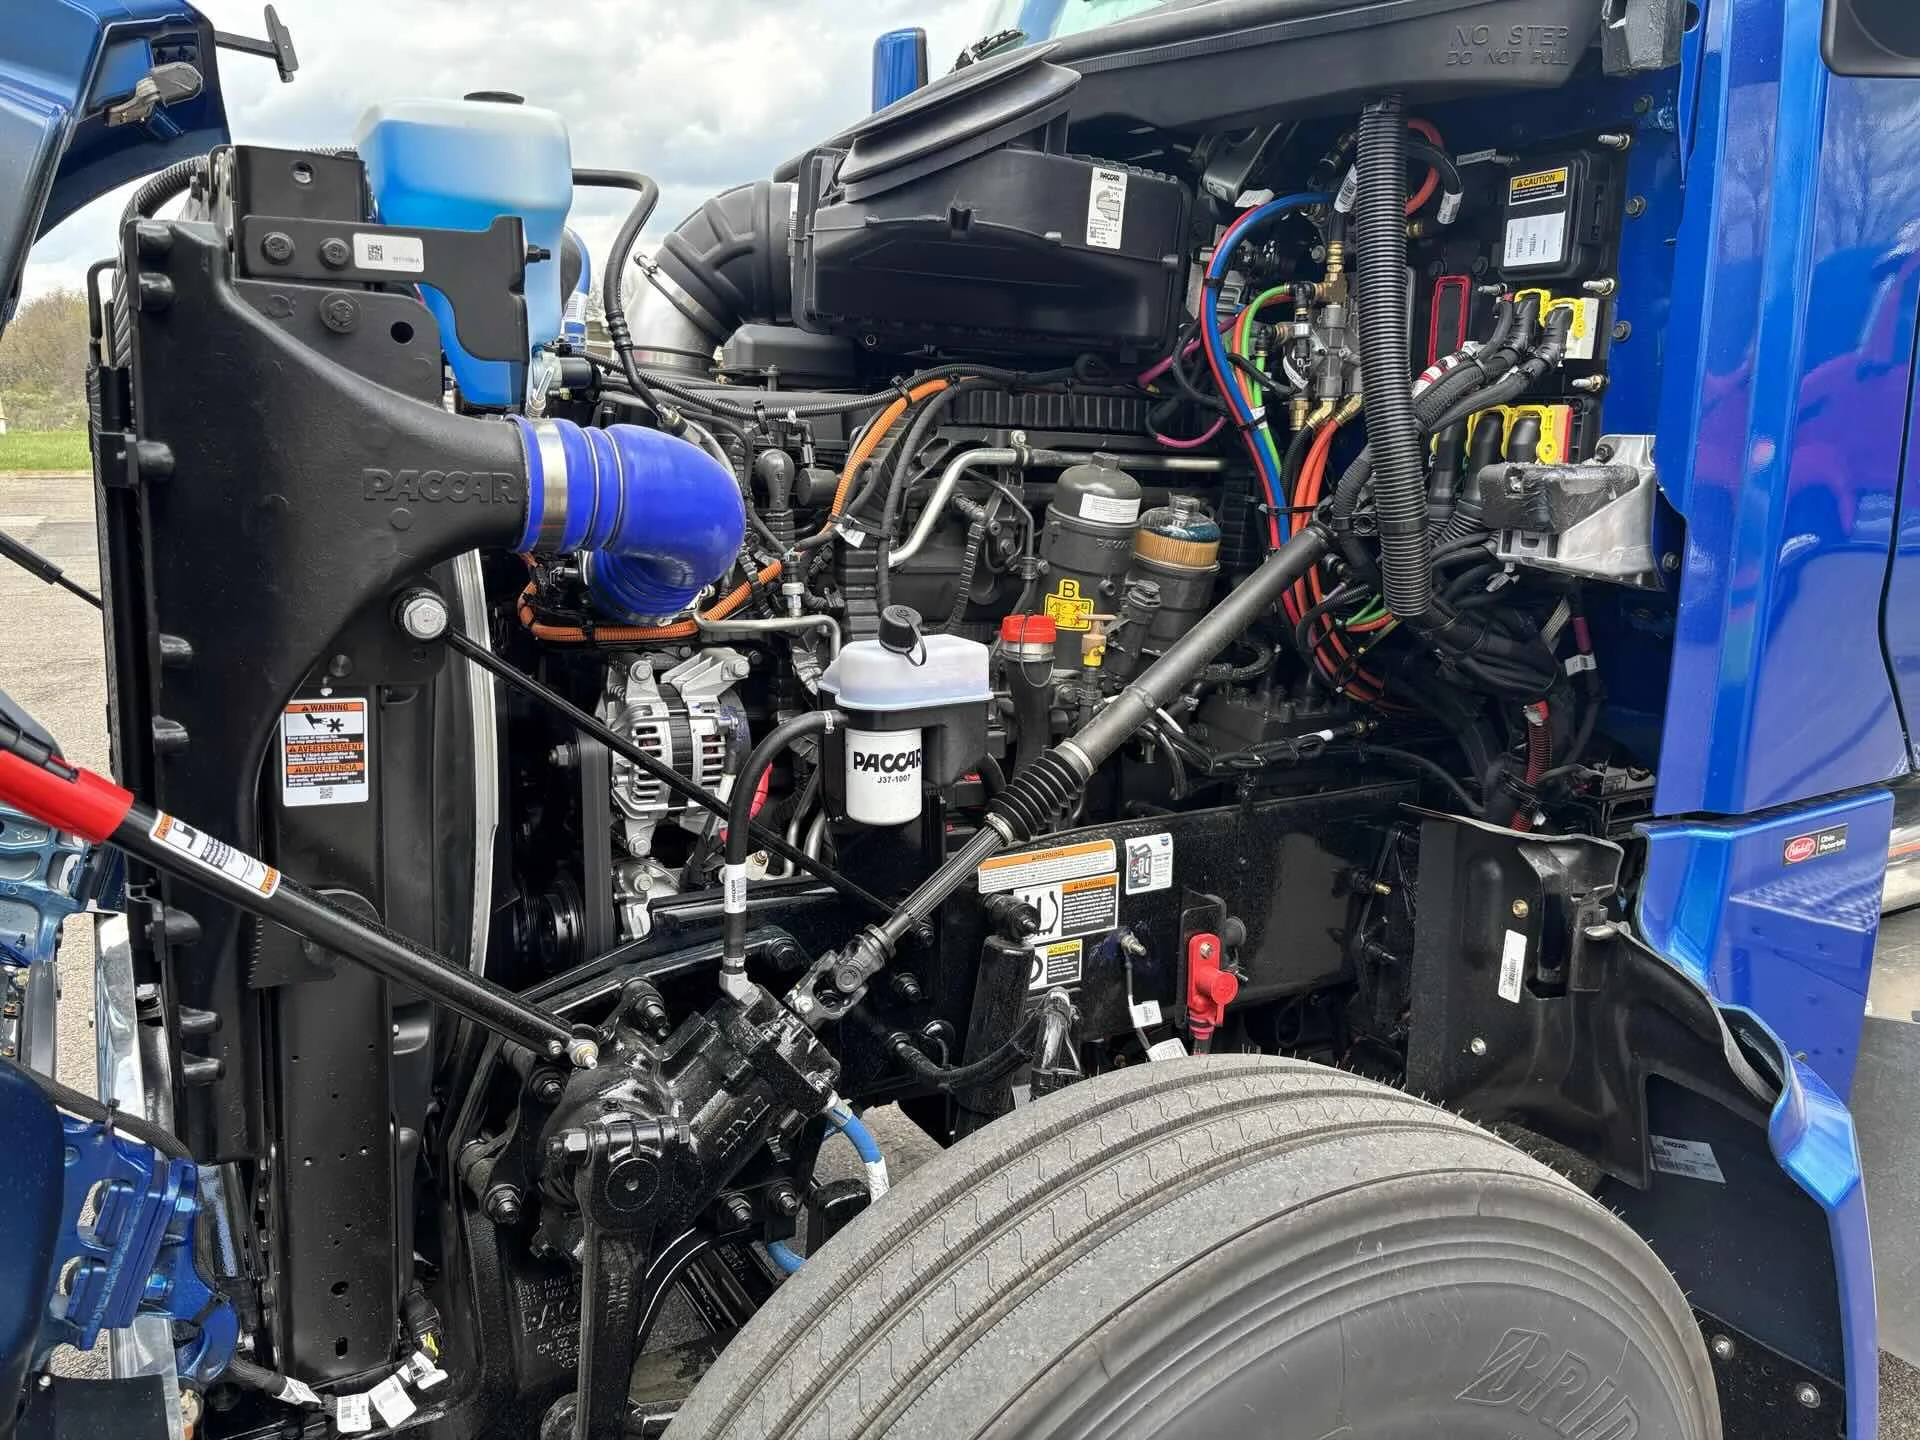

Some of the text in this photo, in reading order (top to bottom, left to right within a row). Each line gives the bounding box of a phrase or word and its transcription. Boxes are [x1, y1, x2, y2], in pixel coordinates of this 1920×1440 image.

[1449, 24, 1569, 47] NO STEP
[1446, 48, 1569, 65] DO NOT PULL
[1523, 174, 1556, 187] CAUTION
[362, 467, 520, 504] PACCAR
[1063, 581, 1075, 598] B
[310, 703, 349, 712] WARNING
[298, 742, 364, 752] AVERTISSEMENT
[853, 748, 921, 773] PACCAR
[303, 764, 358, 773] ADVERTENCIA
[877, 774, 911, 784] J37-1007
